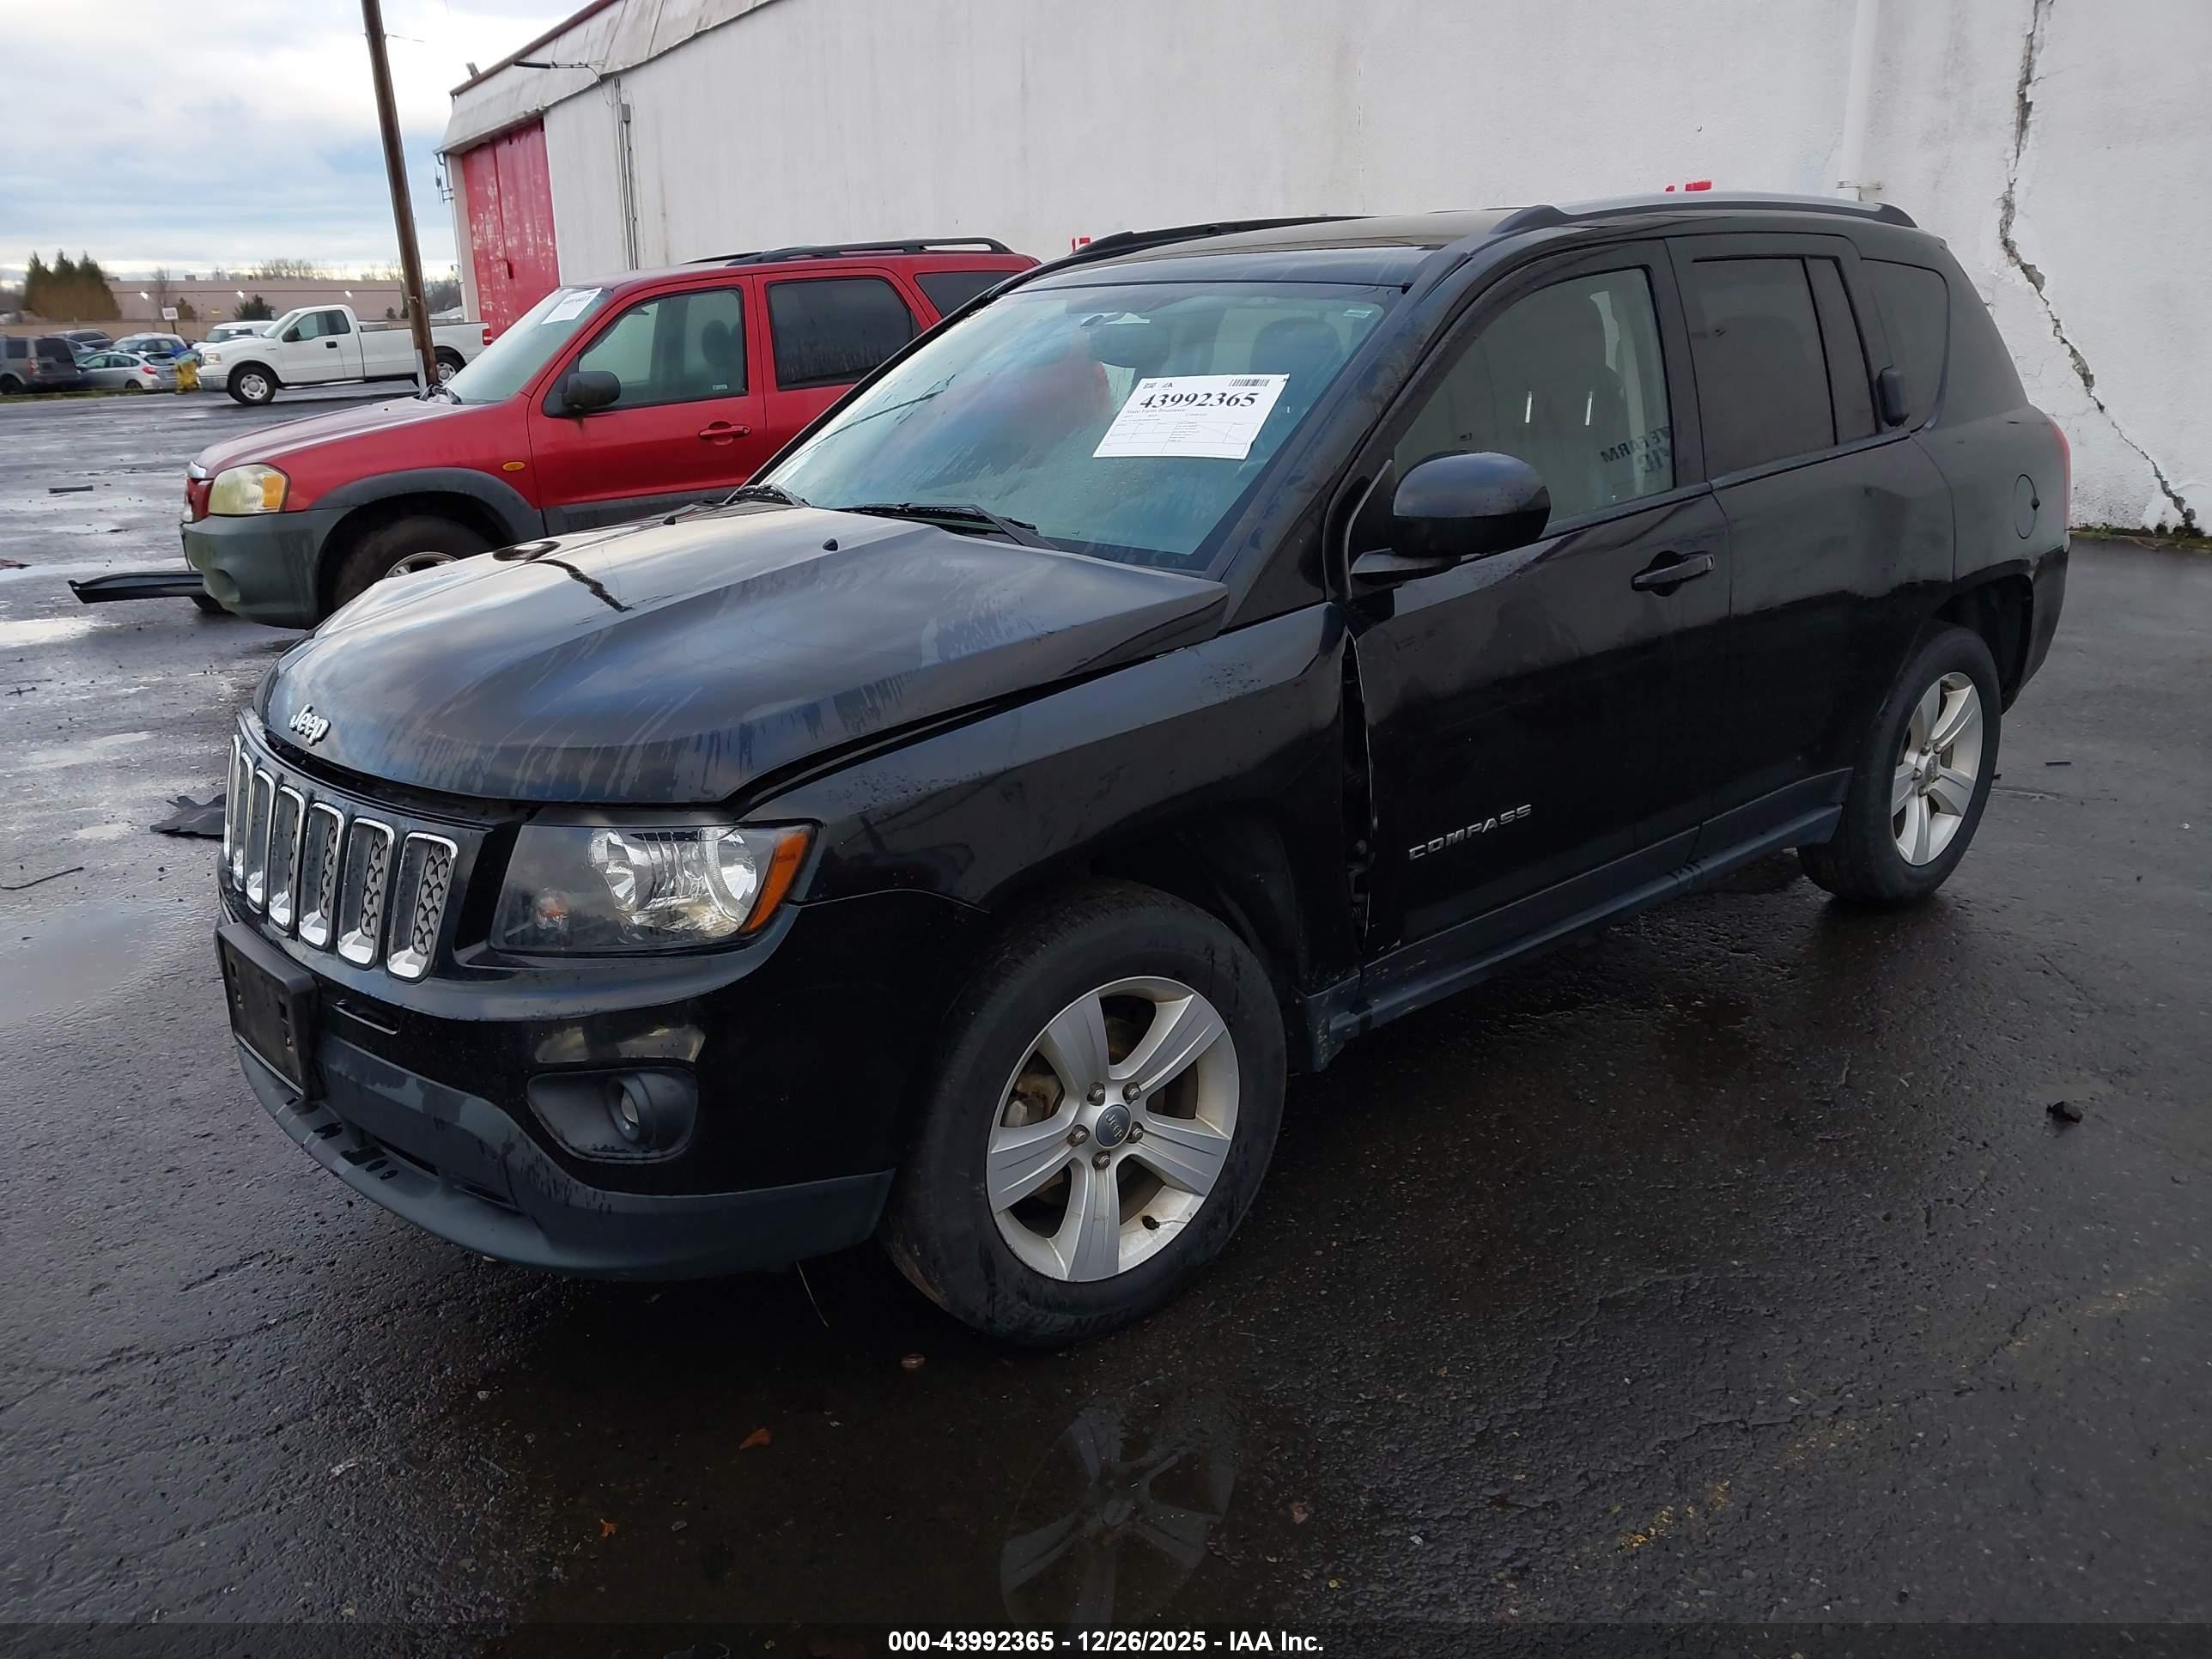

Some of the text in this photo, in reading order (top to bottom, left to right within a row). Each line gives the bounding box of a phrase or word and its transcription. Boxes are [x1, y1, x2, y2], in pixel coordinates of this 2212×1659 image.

[1139, 392, 1260, 408] 43992365
[289, 703, 330, 745] Jeep
[1408, 804, 1532, 861] COMPASS
